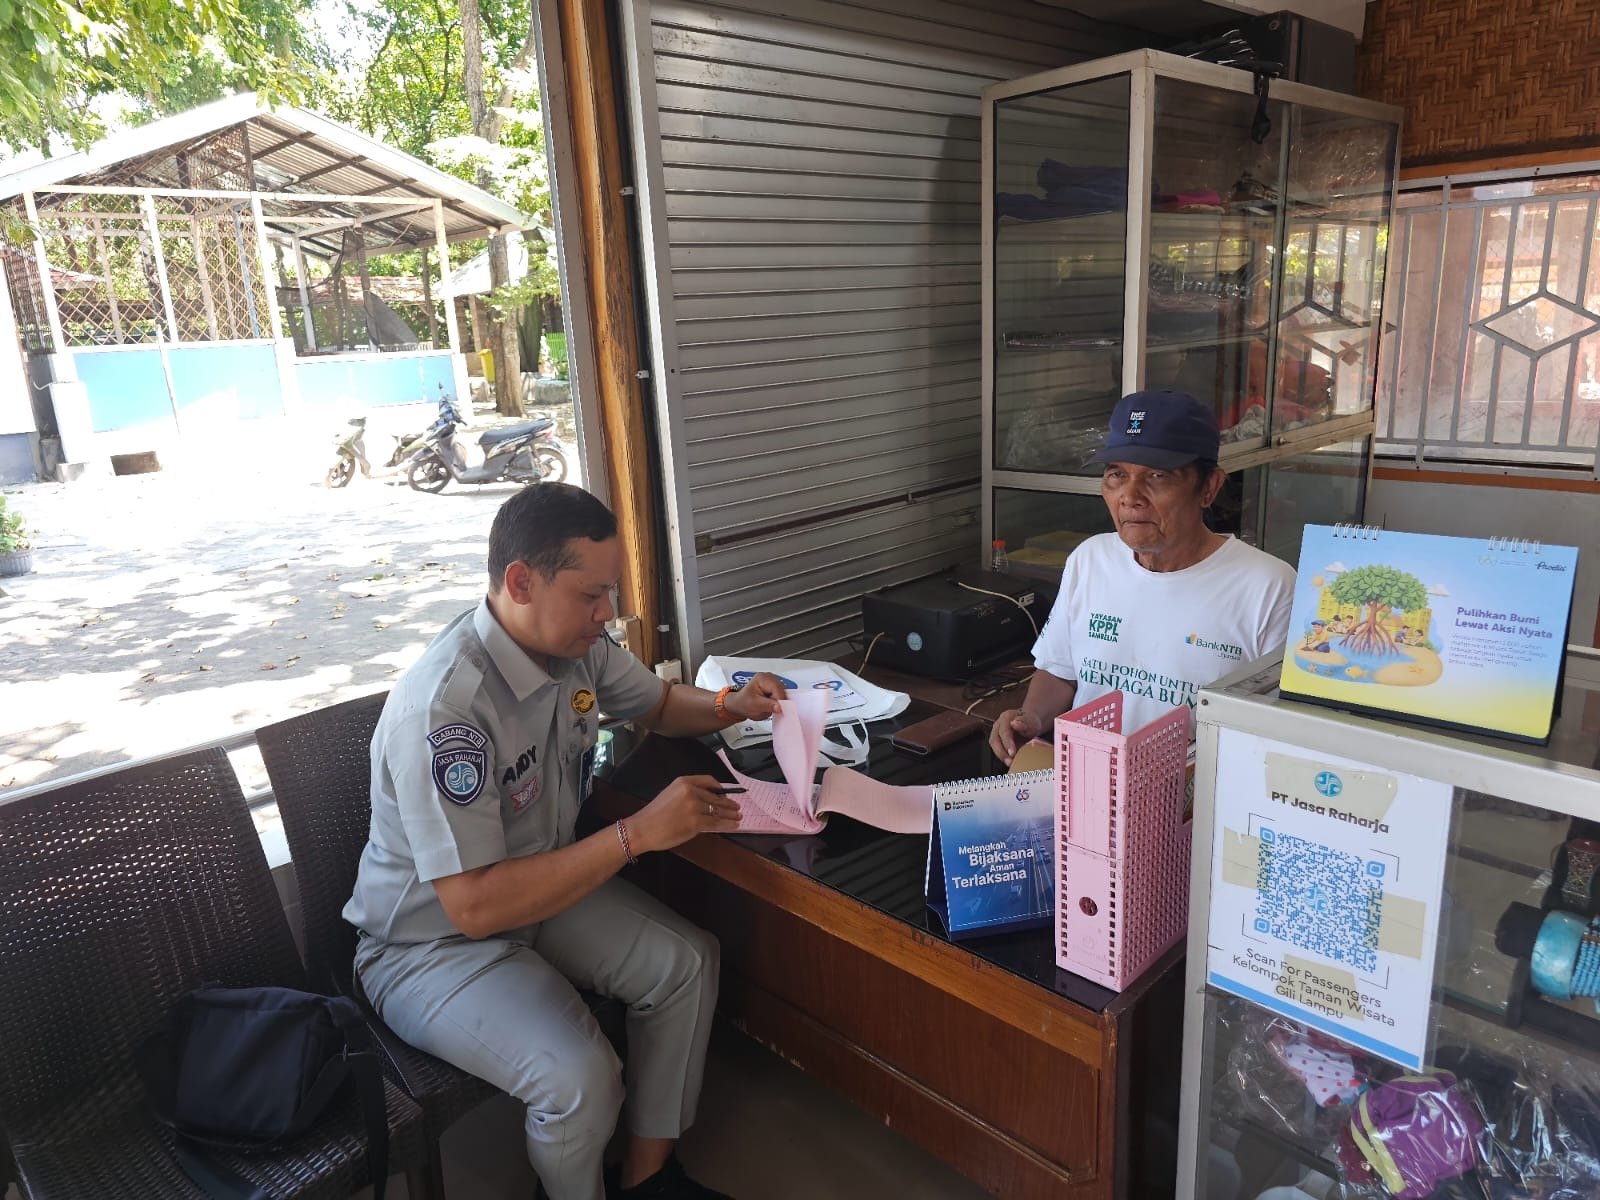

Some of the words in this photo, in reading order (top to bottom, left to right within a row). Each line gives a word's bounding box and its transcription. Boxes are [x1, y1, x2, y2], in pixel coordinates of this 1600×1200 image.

[1090, 612, 1122, 624] YAYASAN
[1456, 606, 1507, 621] Pulihkan
[1510, 613, 1540, 625] Bumi
[1088, 618, 1119, 636] KPPL
[1455, 618, 1489, 631] Lewat
[1491, 622, 1516, 634] Aksi
[1518, 626, 1553, 639] Nyata
[1079, 667, 1154, 699] MENJAGA
[1082, 656, 1108, 672] SATU
[1111, 663, 1157, 683] POHON
[1159, 674, 1201, 695] UNTU
[434, 727, 467, 742] CABANG
[437, 756, 455, 767] JASA
[502, 745, 537, 786] ANDY
[1015, 788, 1030, 802] 65
[1271, 791, 1289, 805] PT
[1290, 798, 1326, 816] Jasa
[1328, 807, 1390, 834] Raharja
[958, 841, 1006, 856] Melangkah
[969, 847, 1035, 868] Bijaksana
[989, 862, 1015, 874] Aman
[951, 868, 1027, 890] Terlaksana
[1246, 948, 1276, 968] Scan
[1280, 960, 1301, 976] For
[1304, 970, 1382, 1008] Passengers
[1233, 955, 1295, 988] Kelompok
[1298, 980, 1342, 1007] Taman
[1346, 999, 1395, 1027] Wisata
[1275, 985, 1296, 1000] Gili
[1299, 996, 1344, 1020] Lampu
